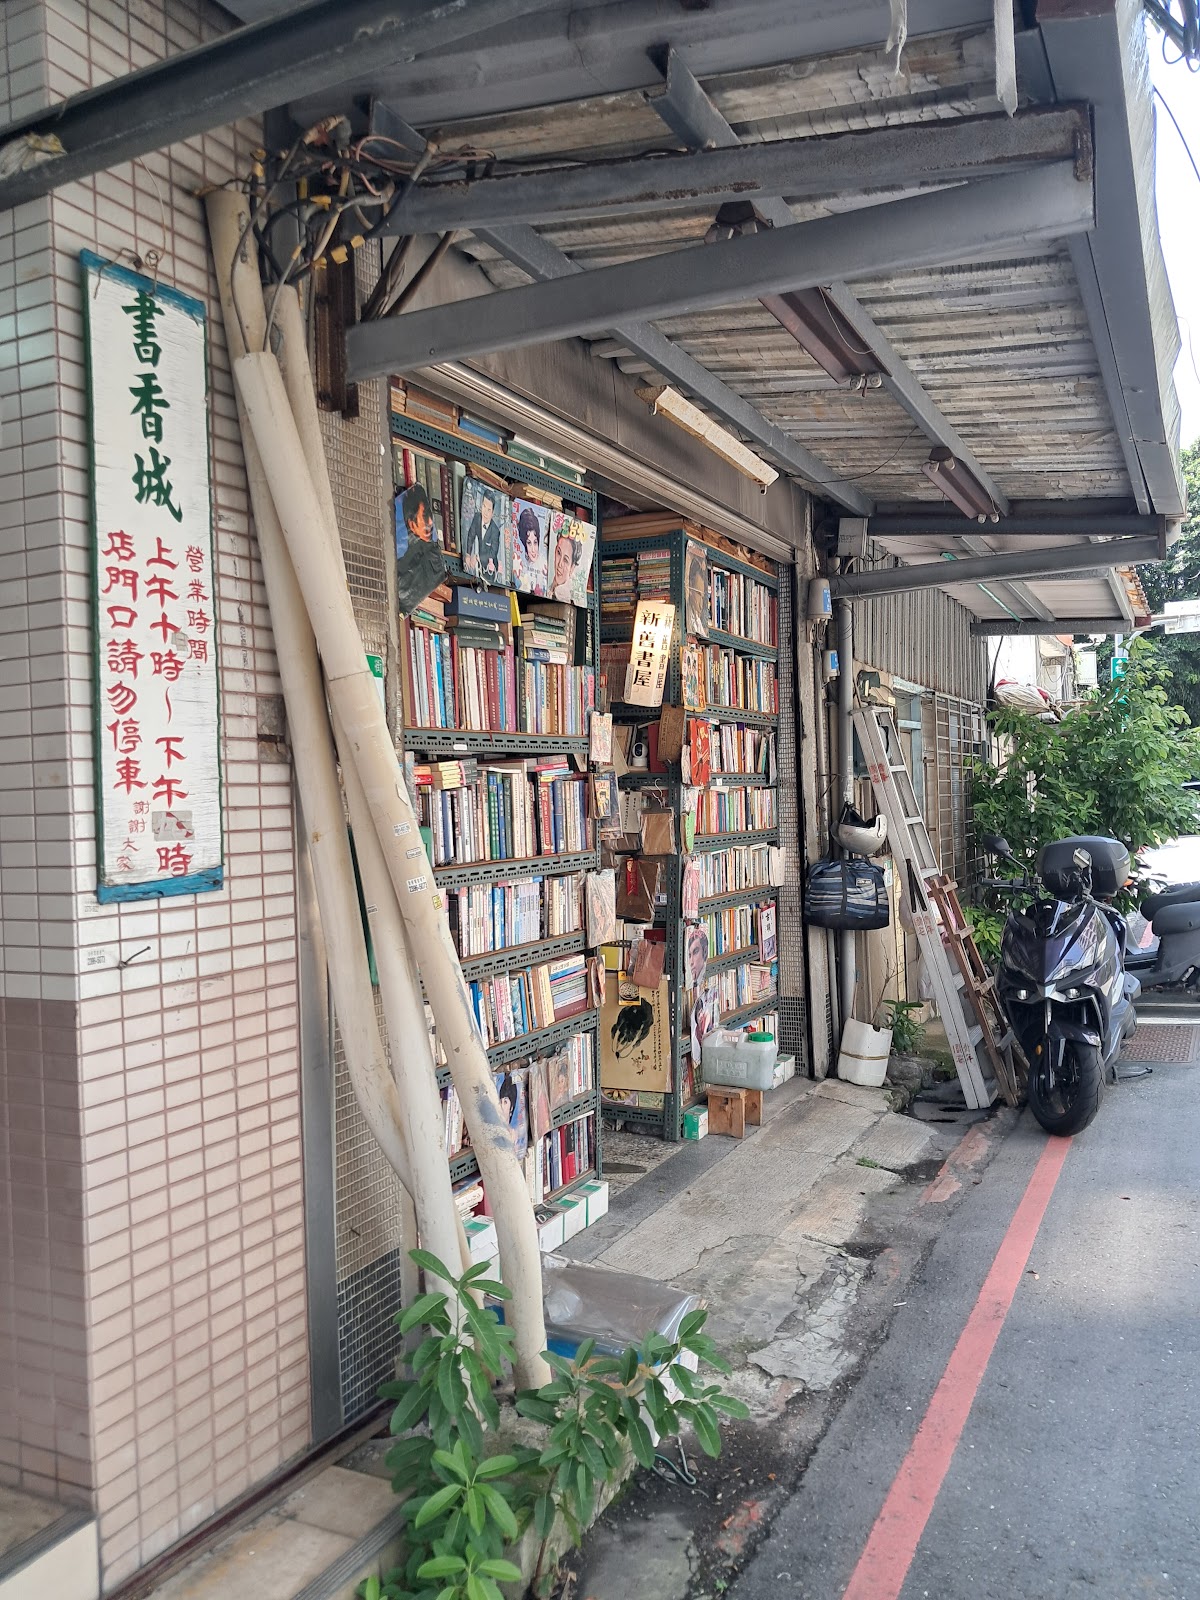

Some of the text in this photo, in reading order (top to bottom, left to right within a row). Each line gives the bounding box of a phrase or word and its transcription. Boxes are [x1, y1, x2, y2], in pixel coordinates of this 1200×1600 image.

[121, 288, 183, 523] 書香城
[101, 529, 148, 796] 店門口請勿停車
[115, 799, 151, 873] 謝謝大家
